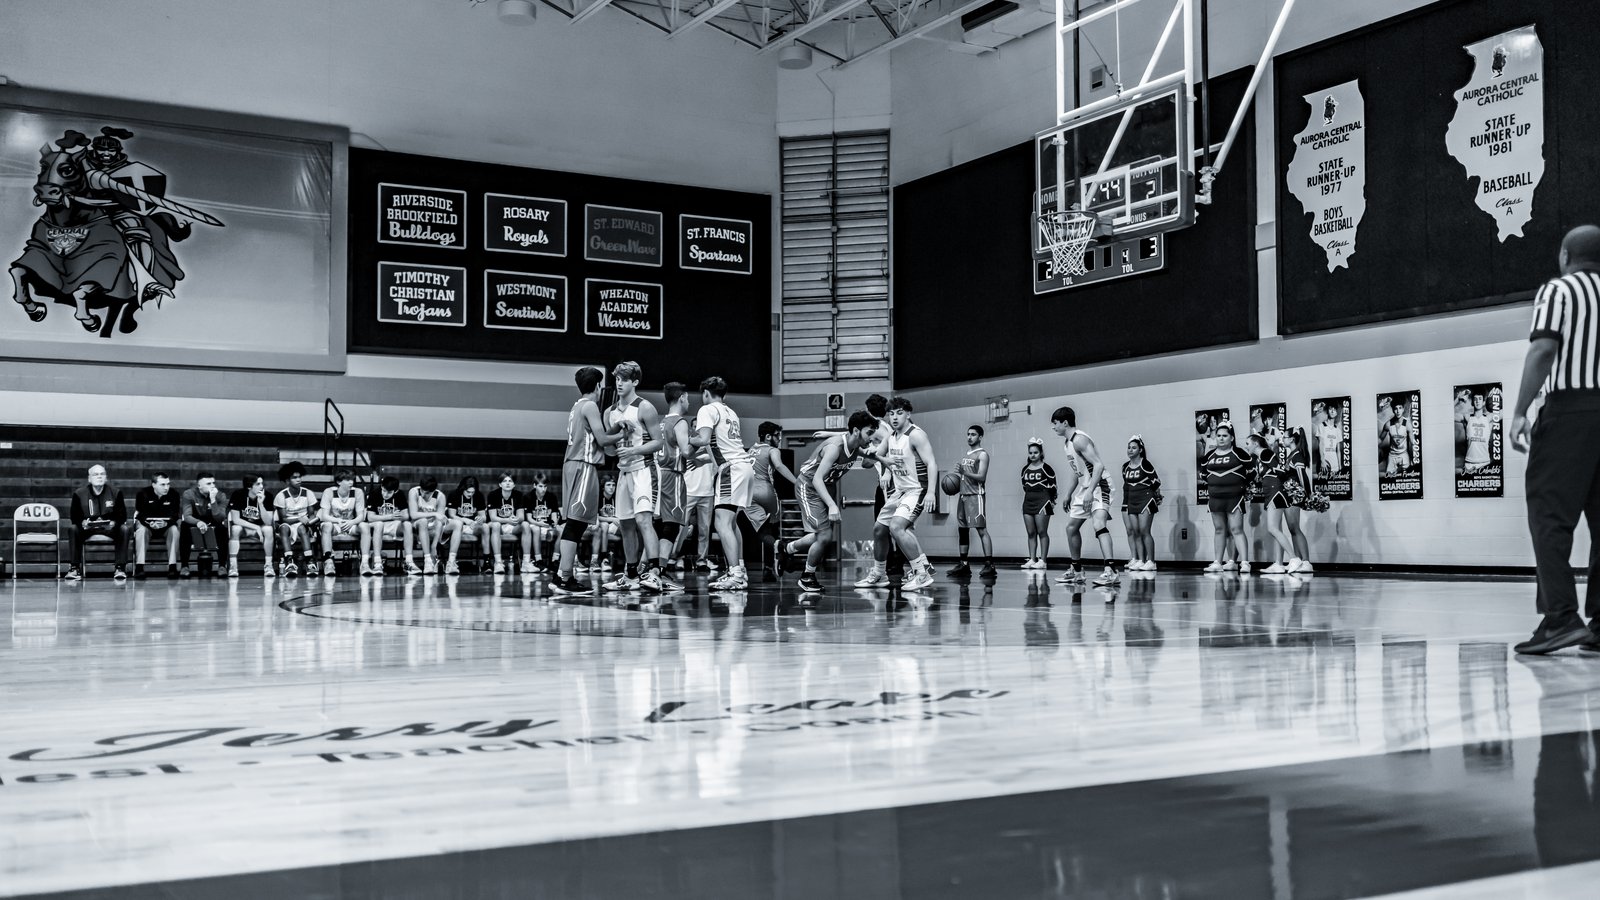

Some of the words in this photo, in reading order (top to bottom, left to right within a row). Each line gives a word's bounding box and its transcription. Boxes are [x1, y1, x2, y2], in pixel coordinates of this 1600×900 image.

[1462, 84, 1499, 101] AURORA
[1499, 72, 1539, 91] CENTRAL
[1477, 87, 1524, 107] CATHOLIC
[1484, 113, 1516, 132] STATE
[1300, 129, 1329, 146] AURORA
[1330, 120, 1362, 137] CENTRAL
[1312, 132, 1350, 150] CATHOLIC
[1470, 123, 1531, 148] RUNNER-UP
[1489, 140, 1512, 157] 1981
[1318, 157, 1344, 174] STATE
[1307, 166, 1356, 188] RUNNER-UP
[1483, 171, 1533, 194] BASEBALL
[1320, 181, 1342, 196] 1977
[392, 194, 453, 212] RIVERSIDE
[1495, 198, 1523, 208] Class
[1505, 206, 1513, 216] A
[387, 208, 458, 225] BROOKFIELD
[503, 207, 550, 222] ROSARY
[1323, 205, 1343, 221] BOYS
[389, 221, 456, 246] Bulldogs
[593, 218, 609, 230] ST.
[611, 218, 655, 235] EDWARD
[1314, 216, 1354, 237] BASKETBALL
[503, 225, 549, 247] Royals
[687, 228, 702, 240] ST.
[703, 227, 746, 244] FRANCIS
[1149, 236, 1158, 257] 3
[1326, 240, 1350, 249] Class
[1335, 248, 1341, 256] A
[689, 244, 743, 263] Spartans
[1122, 249, 1129, 262] 4
[1046, 260, 1053, 279] 2
[1121, 263, 1134, 274] TOL
[394, 271, 450, 287] TIMOTHY
[1062, 276, 1073, 286] TOL
[389, 286, 455, 302] CHRISTIAN
[496, 283, 557, 300] WESTMONT
[600, 288, 648, 303] WHEATON
[393, 298, 452, 321] Trojans
[495, 301, 556, 321] Sentinels
[600, 301, 649, 314] ACADEMY
[597, 312, 651, 330] Warriors
[831, 395, 841, 409] 4
[1492, 387, 1501, 430] SENIOR
[1342, 400, 1350, 440] SENIOR
[1411, 394, 1419, 435] SENIOR
[1412, 438, 1420, 464] 2023
[1493, 433, 1501, 460] 2023
[1208, 456, 1230, 465] ACC
[1381, 482, 1420, 490] CHARGERS
[1457, 480, 1501, 488] CHARGERS
[23, 505, 52, 518] ACC
[9, 718, 559, 762] Jerry
[0, 763, 192, 786] est
